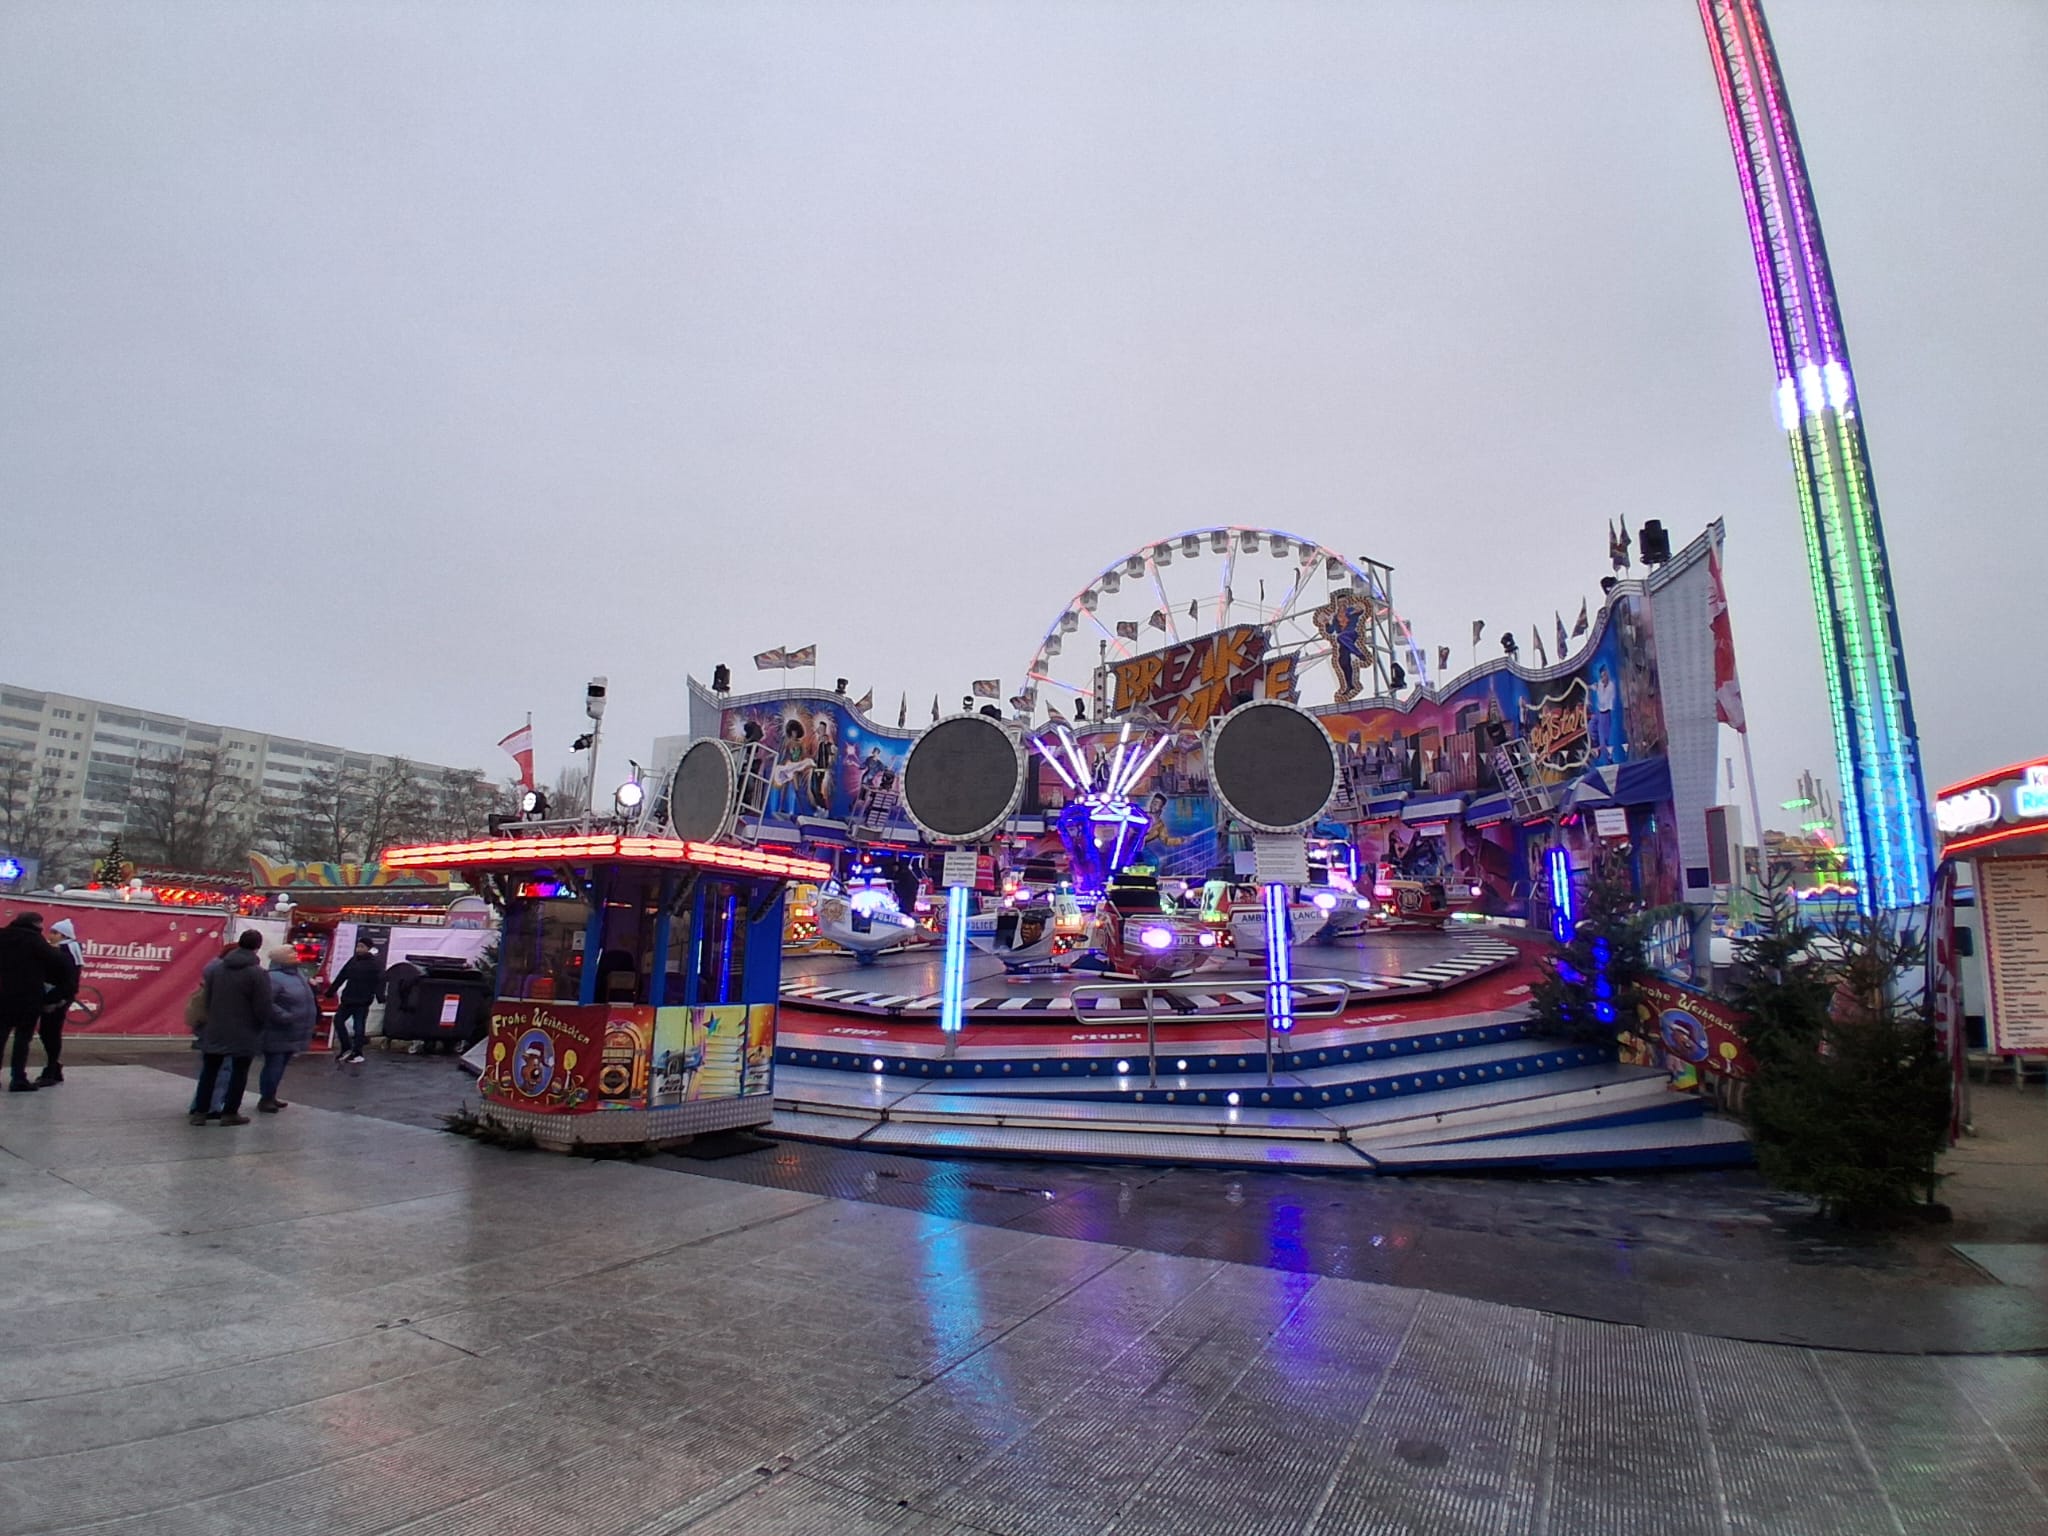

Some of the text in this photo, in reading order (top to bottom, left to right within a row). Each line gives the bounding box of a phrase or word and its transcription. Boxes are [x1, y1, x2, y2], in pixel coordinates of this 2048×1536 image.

[1115, 629, 1262, 711] BREAK
[966, 920, 994, 931] OLICE
[491, 1011, 527, 1037] Frohe
[531, 1007, 591, 1045] Weihnachten
